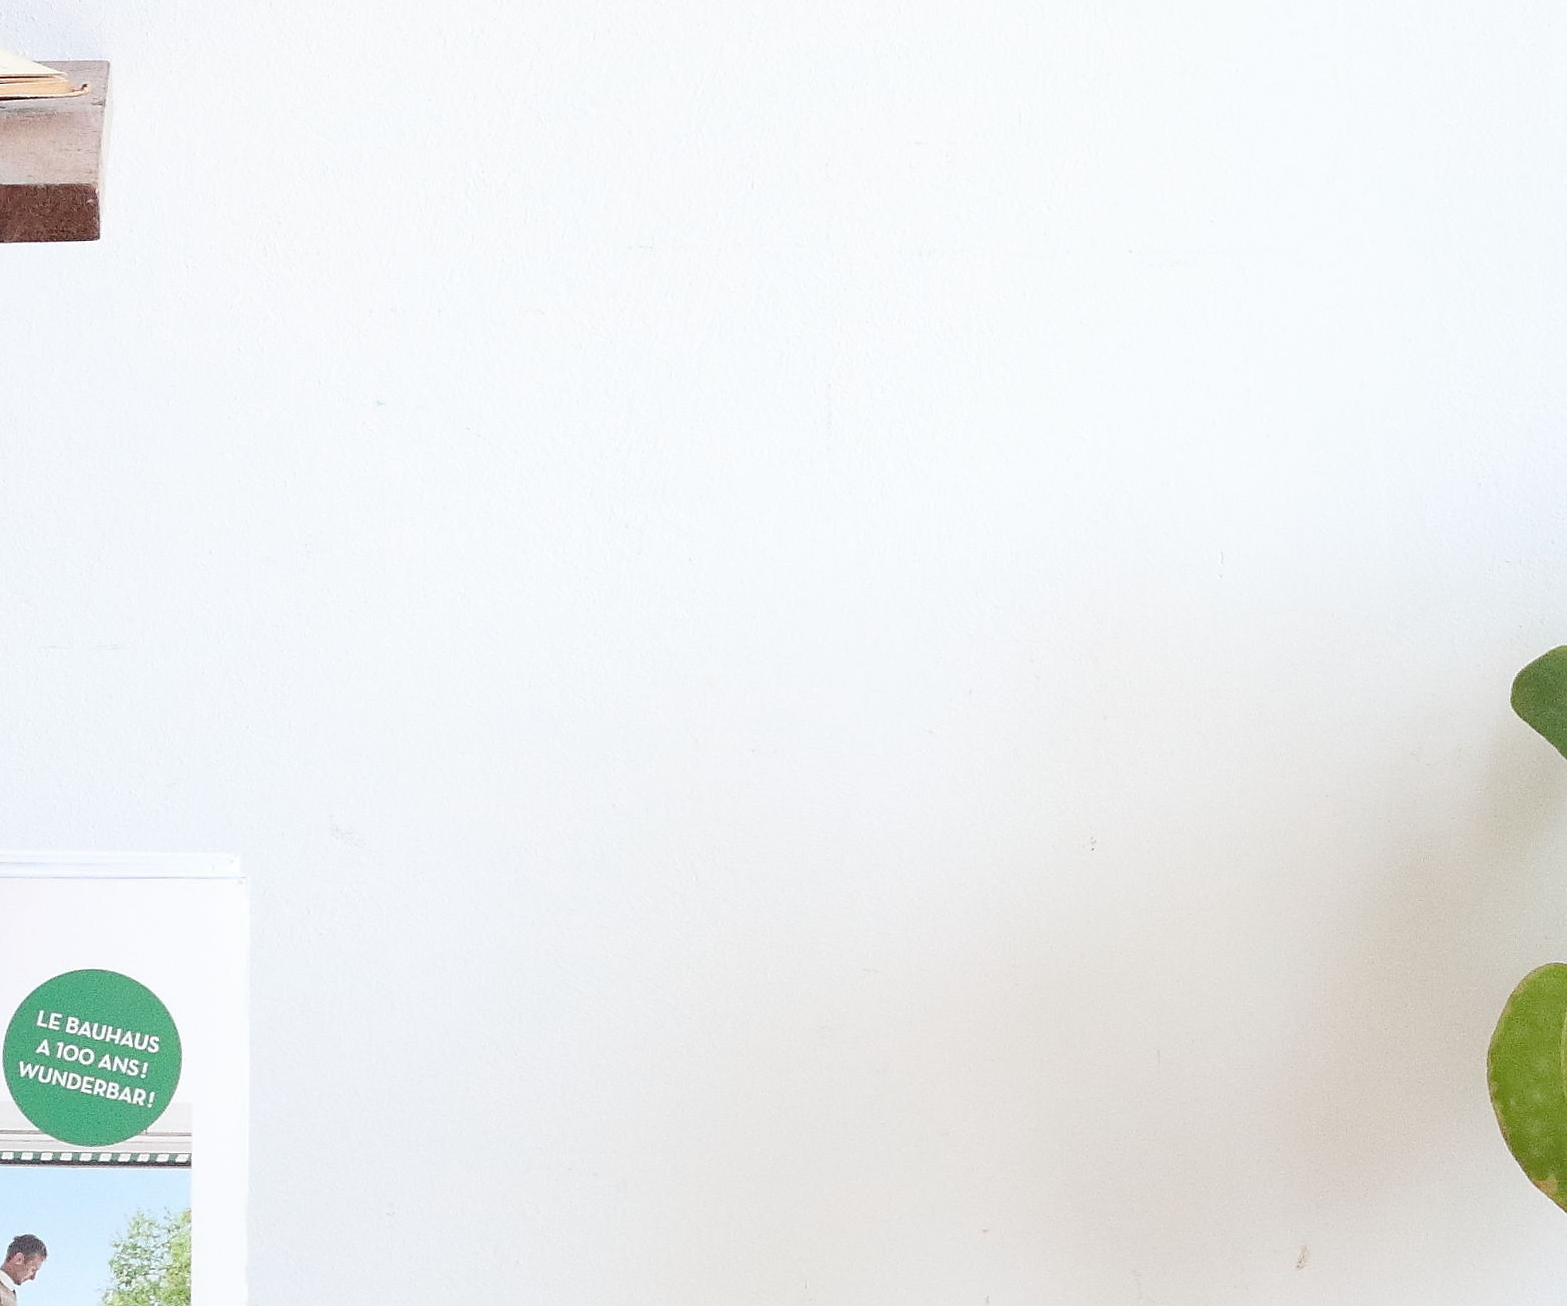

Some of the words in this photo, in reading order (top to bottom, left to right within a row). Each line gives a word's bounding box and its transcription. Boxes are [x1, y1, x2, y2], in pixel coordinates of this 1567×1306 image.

[36, 1010, 63, 1031] LE
[65, 1016, 161, 1054] BAUHAUS
[35, 1039, 51, 1056] A
[56, 1041, 95, 1065] 100
